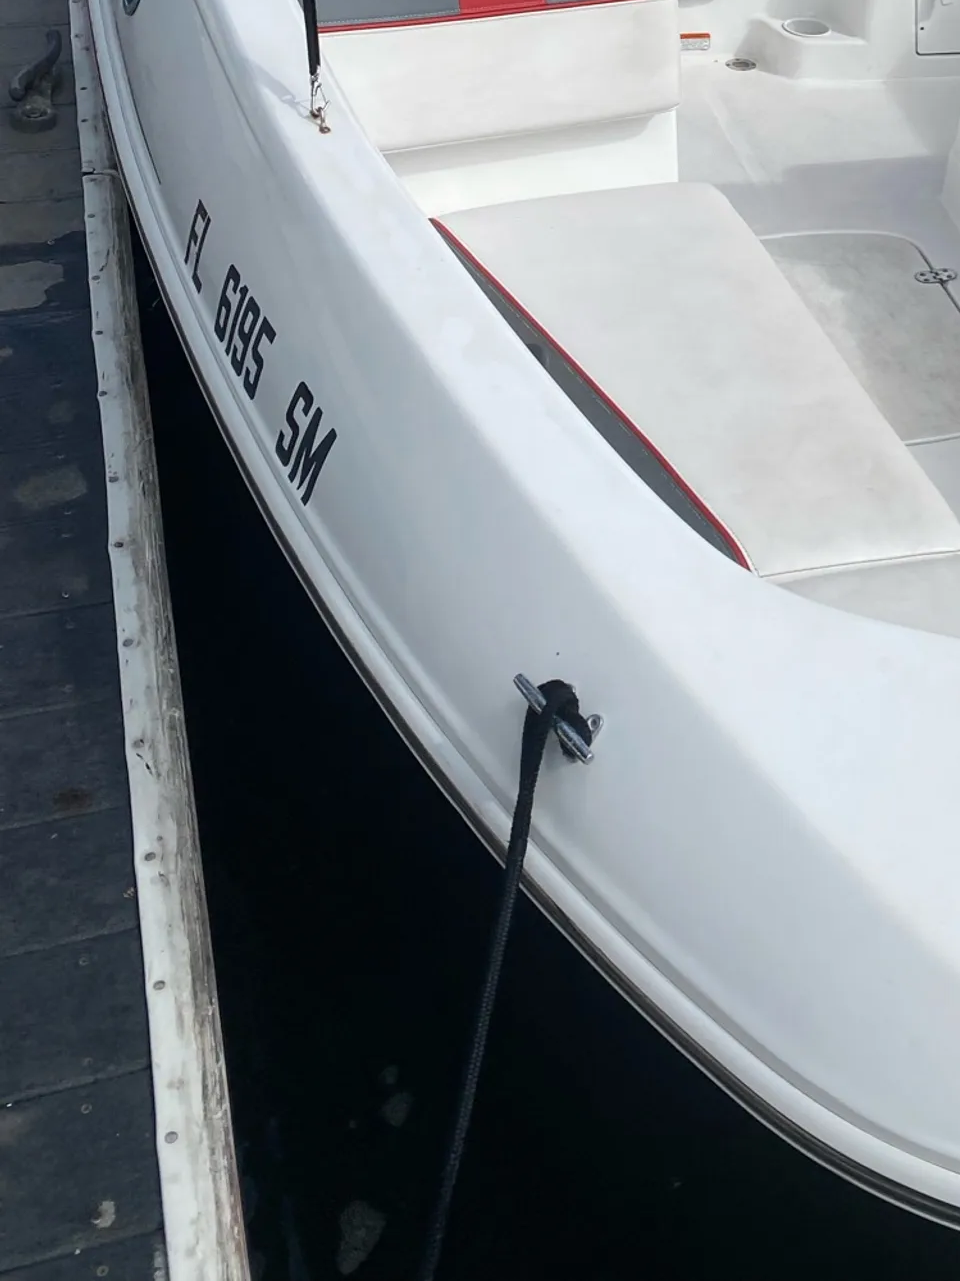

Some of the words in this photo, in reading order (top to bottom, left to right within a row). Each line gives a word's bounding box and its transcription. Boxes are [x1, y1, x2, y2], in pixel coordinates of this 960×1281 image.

[184, 198, 212, 294] FL
[214, 263, 277, 400] 6195
[275, 381, 338, 506] SM
